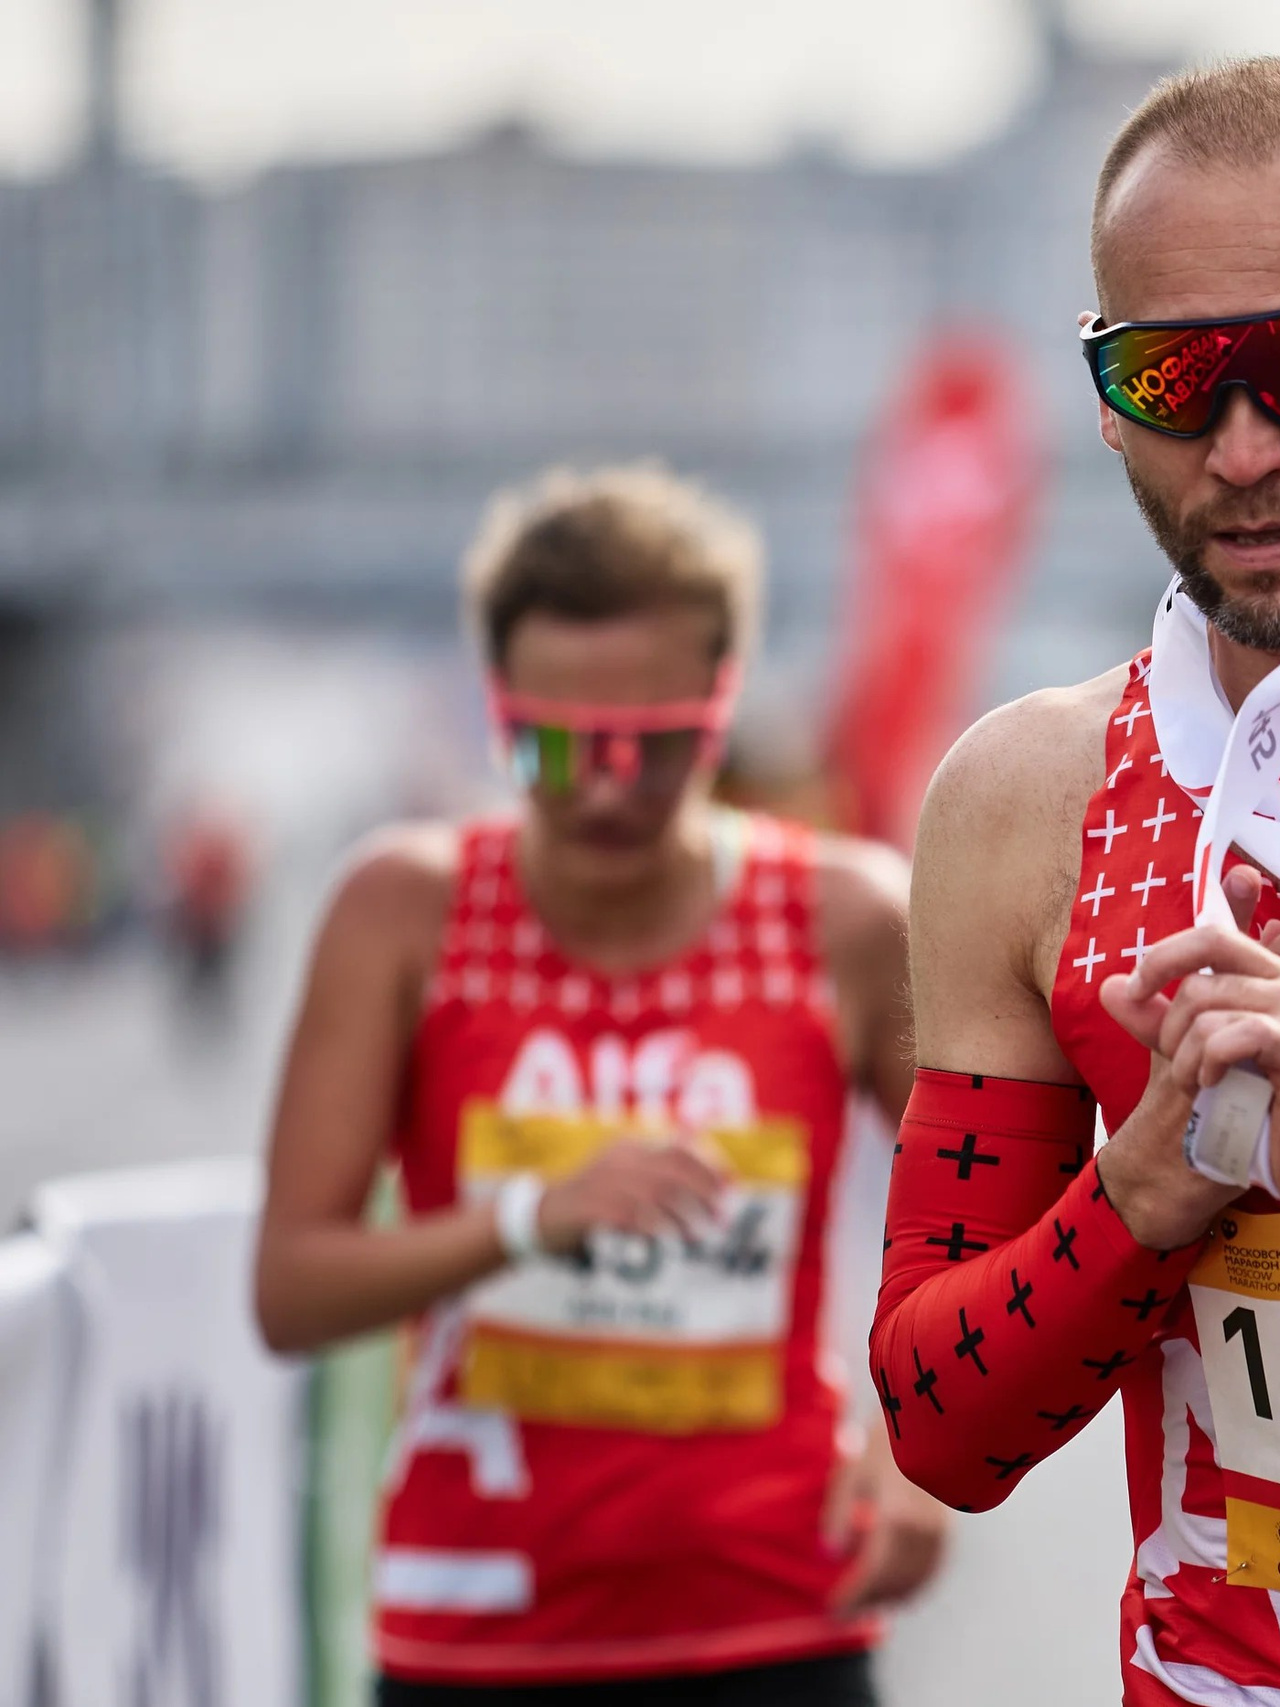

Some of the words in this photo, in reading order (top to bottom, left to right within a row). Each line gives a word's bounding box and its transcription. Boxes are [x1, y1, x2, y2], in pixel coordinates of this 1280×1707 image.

[501, 1025, 757, 1130] Alfa
[1225, 1255, 1280, 1270] МАРАФОН
[1227, 1265, 1273, 1281] MOSCOW
